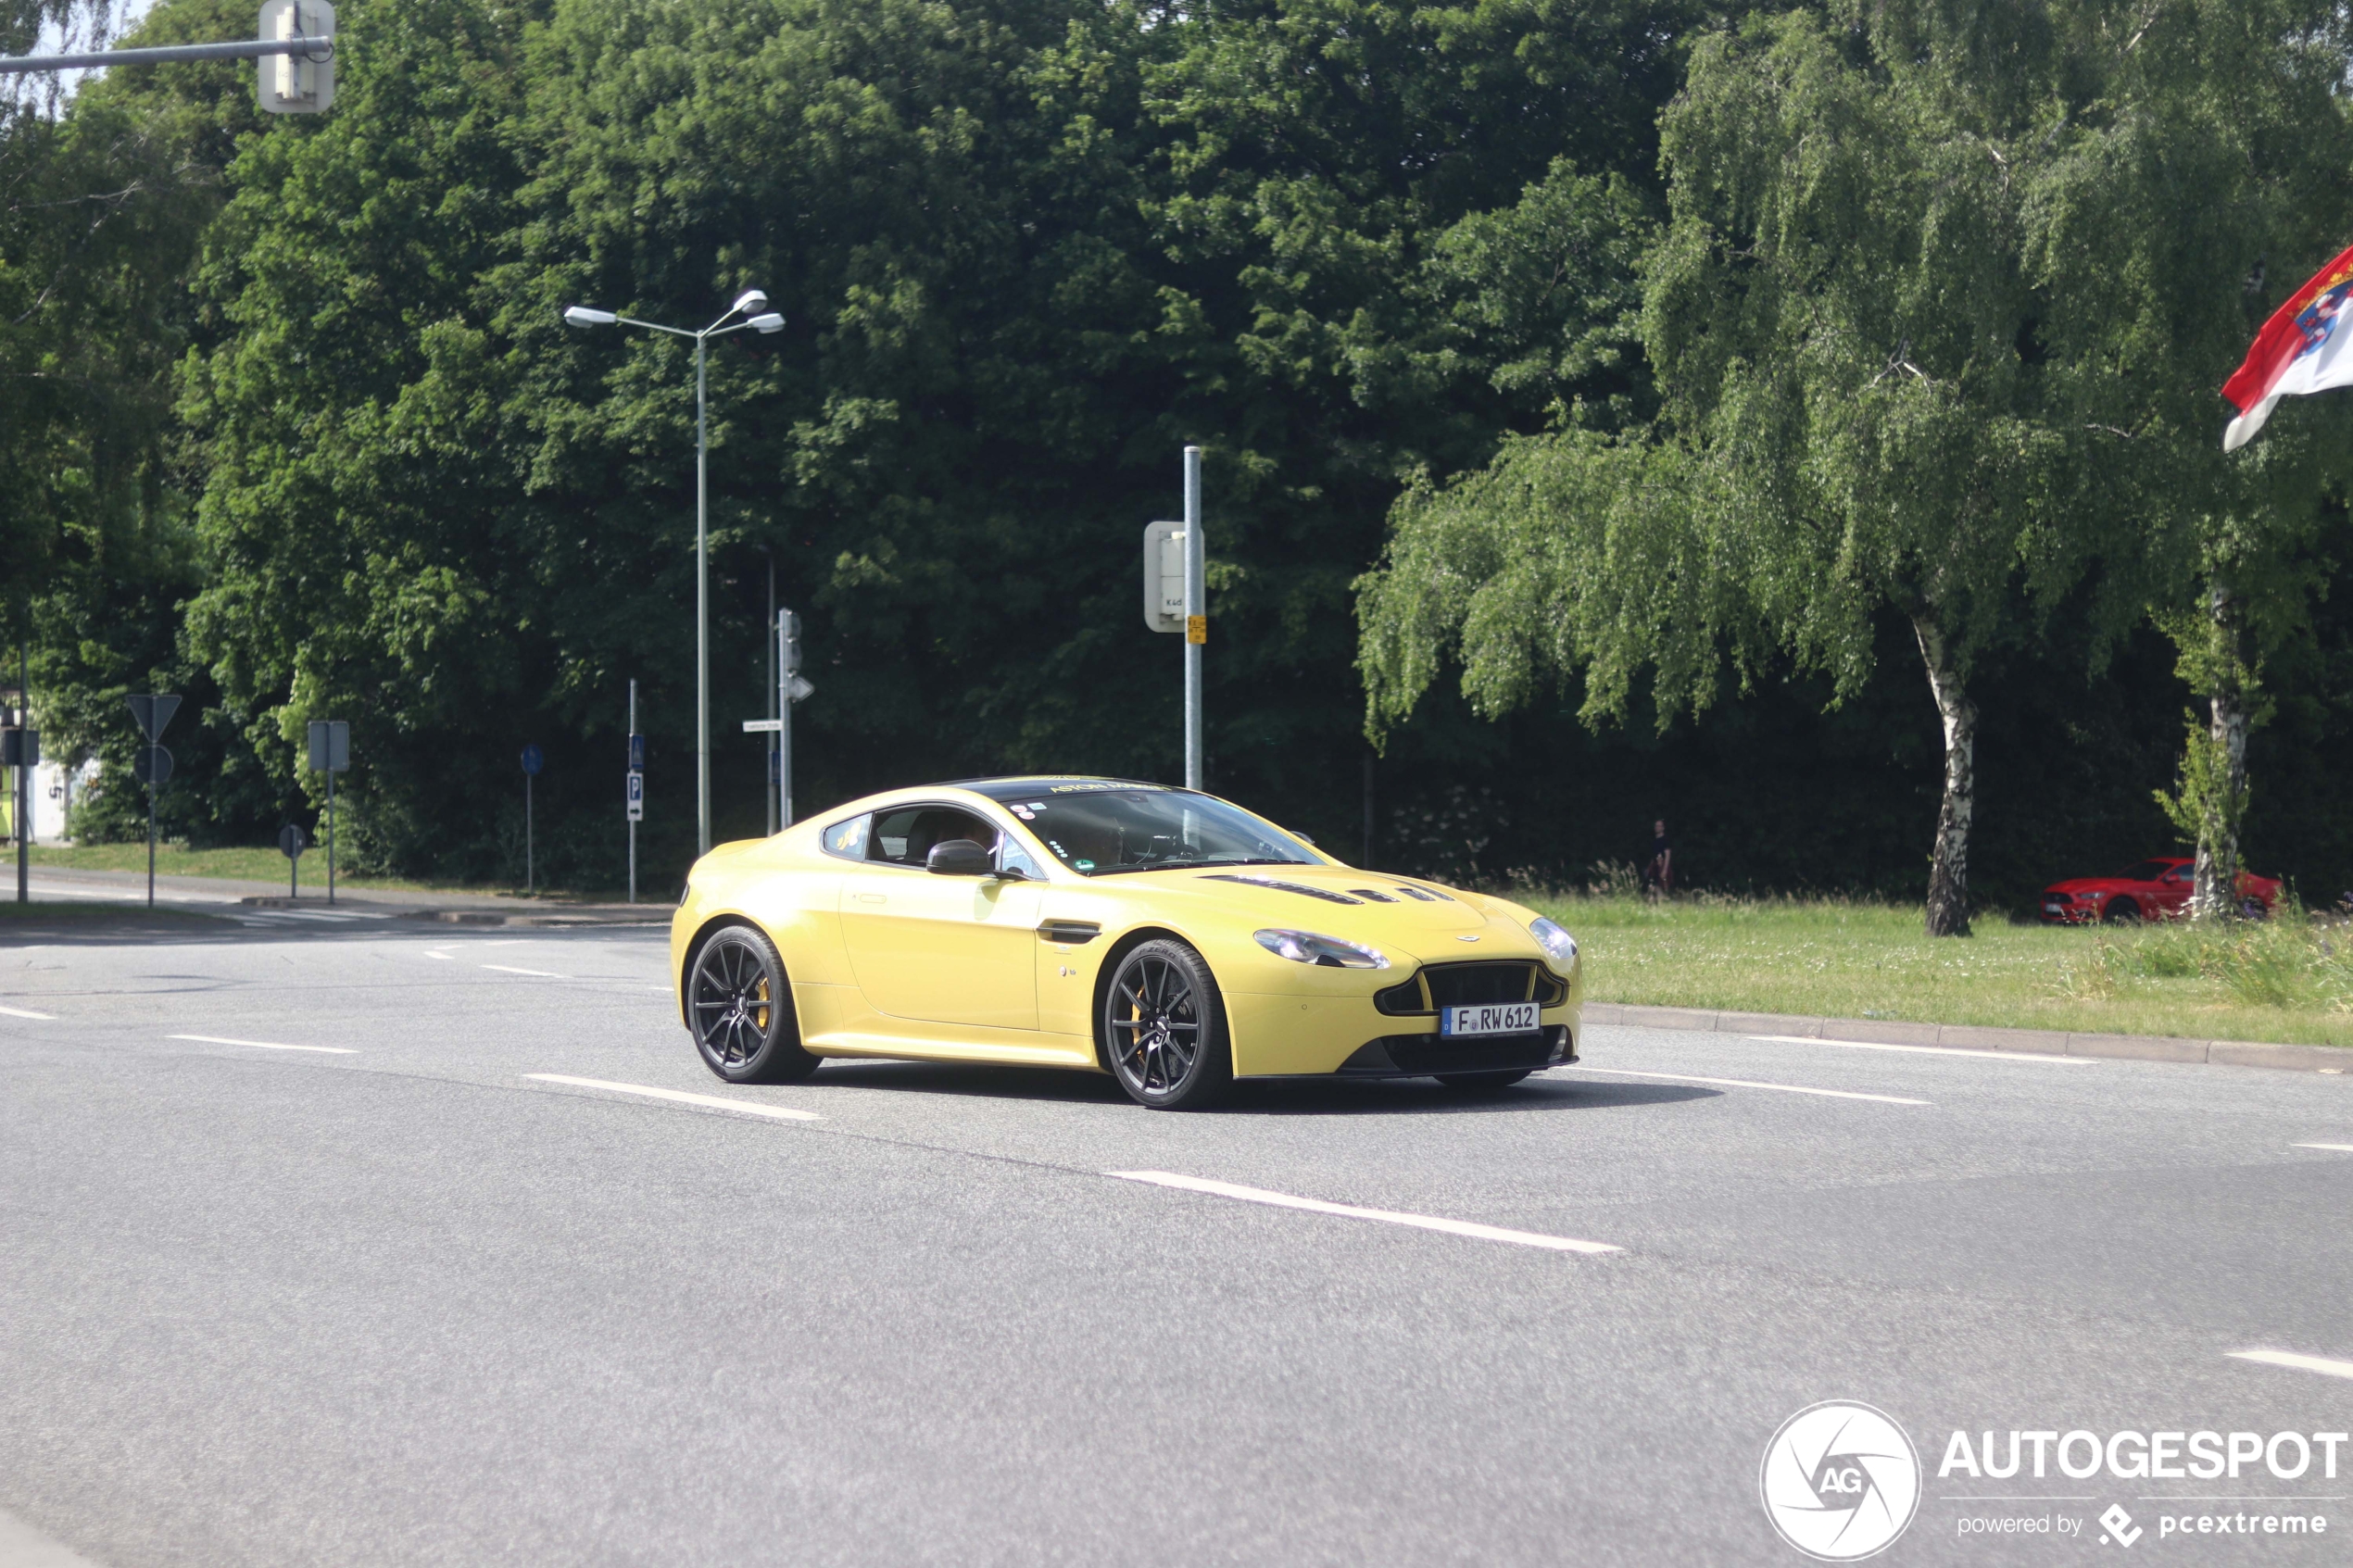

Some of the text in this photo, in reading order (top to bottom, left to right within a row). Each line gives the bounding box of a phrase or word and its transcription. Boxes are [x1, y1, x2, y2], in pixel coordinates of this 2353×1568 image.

[632, 779, 639, 798] P
[1051, 784, 1107, 793] ASTON
[1147, 947, 1176, 959] ZERO
[1459, 1007, 1533, 1031] F RW 612
